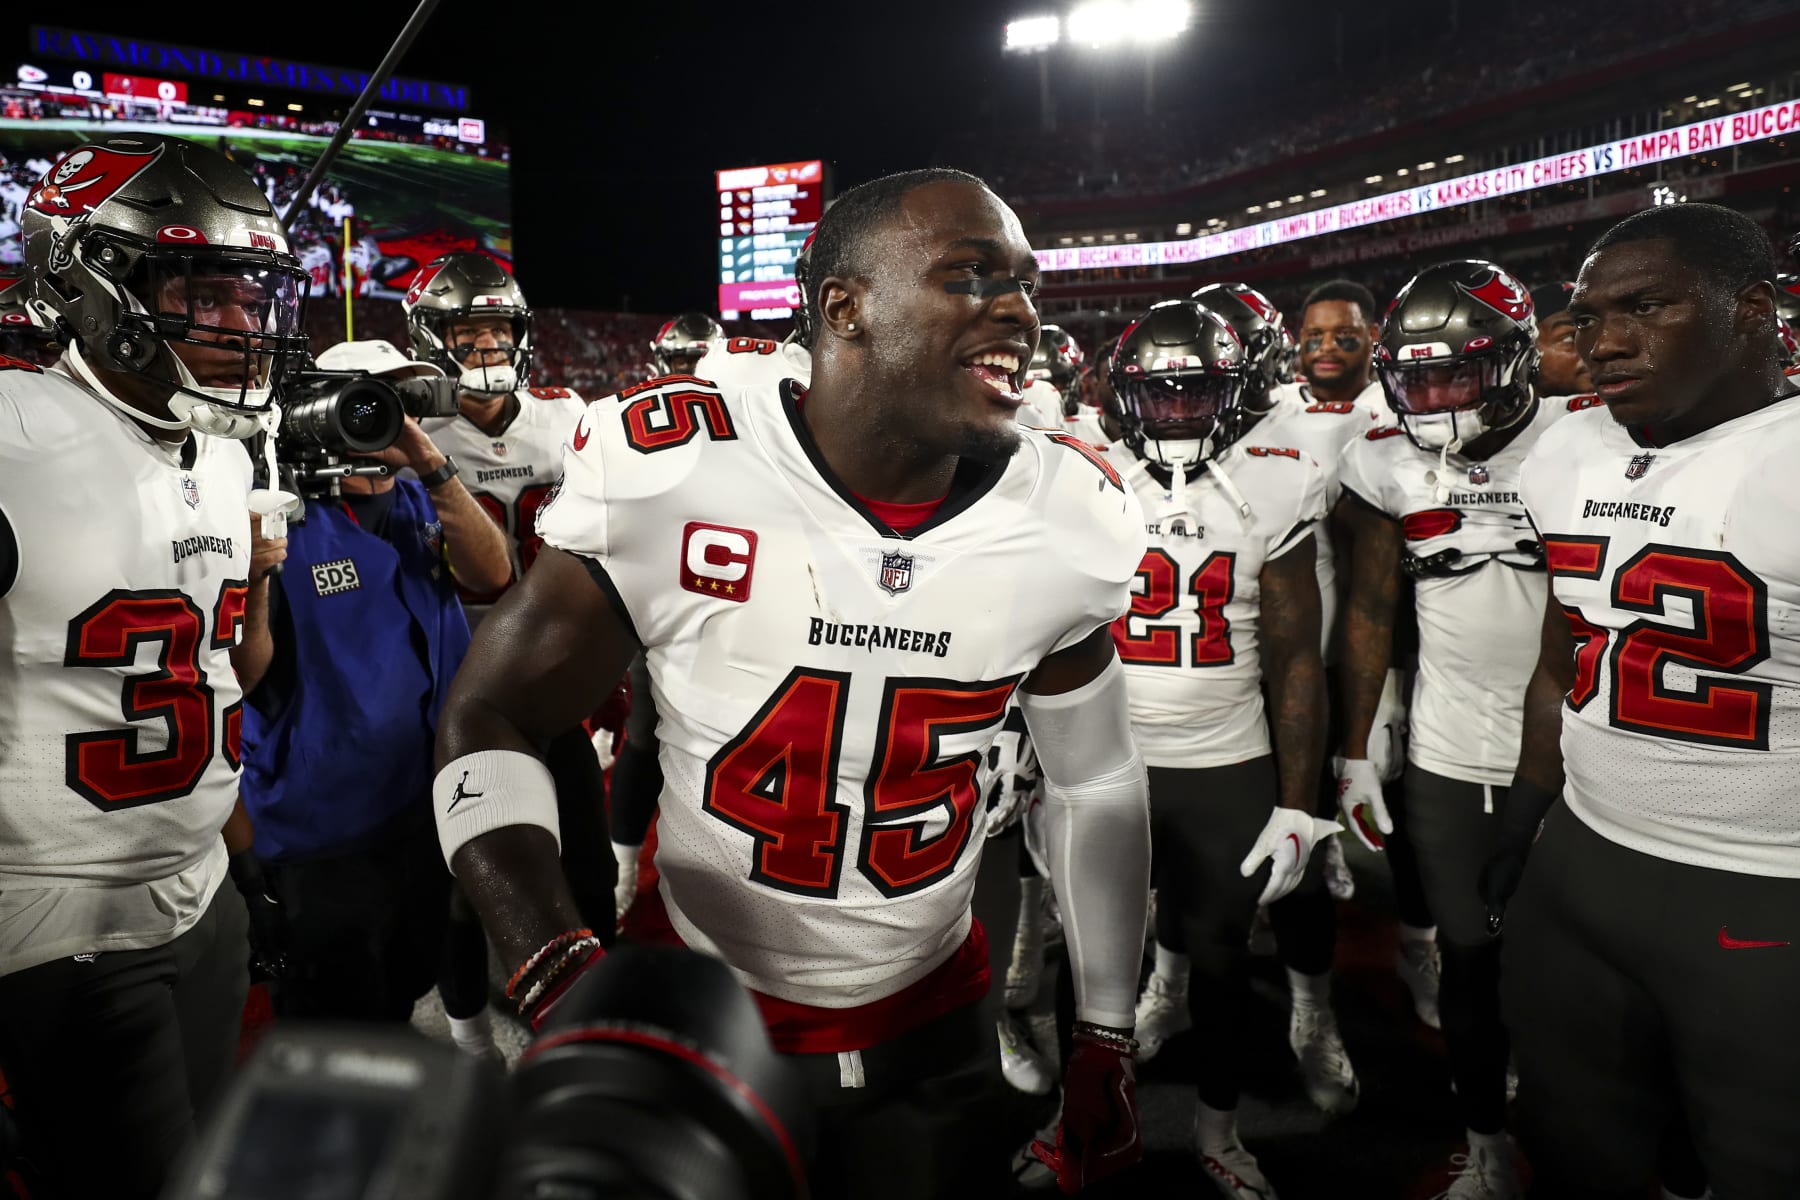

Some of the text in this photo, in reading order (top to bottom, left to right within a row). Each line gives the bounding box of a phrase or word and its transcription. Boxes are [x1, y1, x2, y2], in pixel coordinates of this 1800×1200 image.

[37, 28, 222, 75] RAYMOND
[227, 56, 334, 90] JAMES
[72, 71, 92, 90] 0
[158, 82, 176, 100] 0
[1339, 193, 1413, 224] BUCCANEERS
[1437, 179, 1490, 205] KANSAS
[1494, 167, 1527, 192] CITY
[1533, 153, 1587, 184] CHIEFS
[1593, 147, 1614, 172] VS
[1619, 131, 1681, 166] TAMPA
[1688, 121, 1725, 151] BAY
[476, 465, 534, 484] BUCCANEERS
[1446, 492, 1524, 506] BUCCANEER
[1583, 500, 1675, 527] BUCCANEERS
[172, 535, 233, 564] BUCCANEERS
[687, 528, 750, 582] C
[315, 564, 356, 590] SDS
[883, 568, 907, 588] NFL
[1110, 547, 1237, 668] 21
[808, 616, 952, 658] BUCCANEERS
[702, 665, 1026, 899] 45
